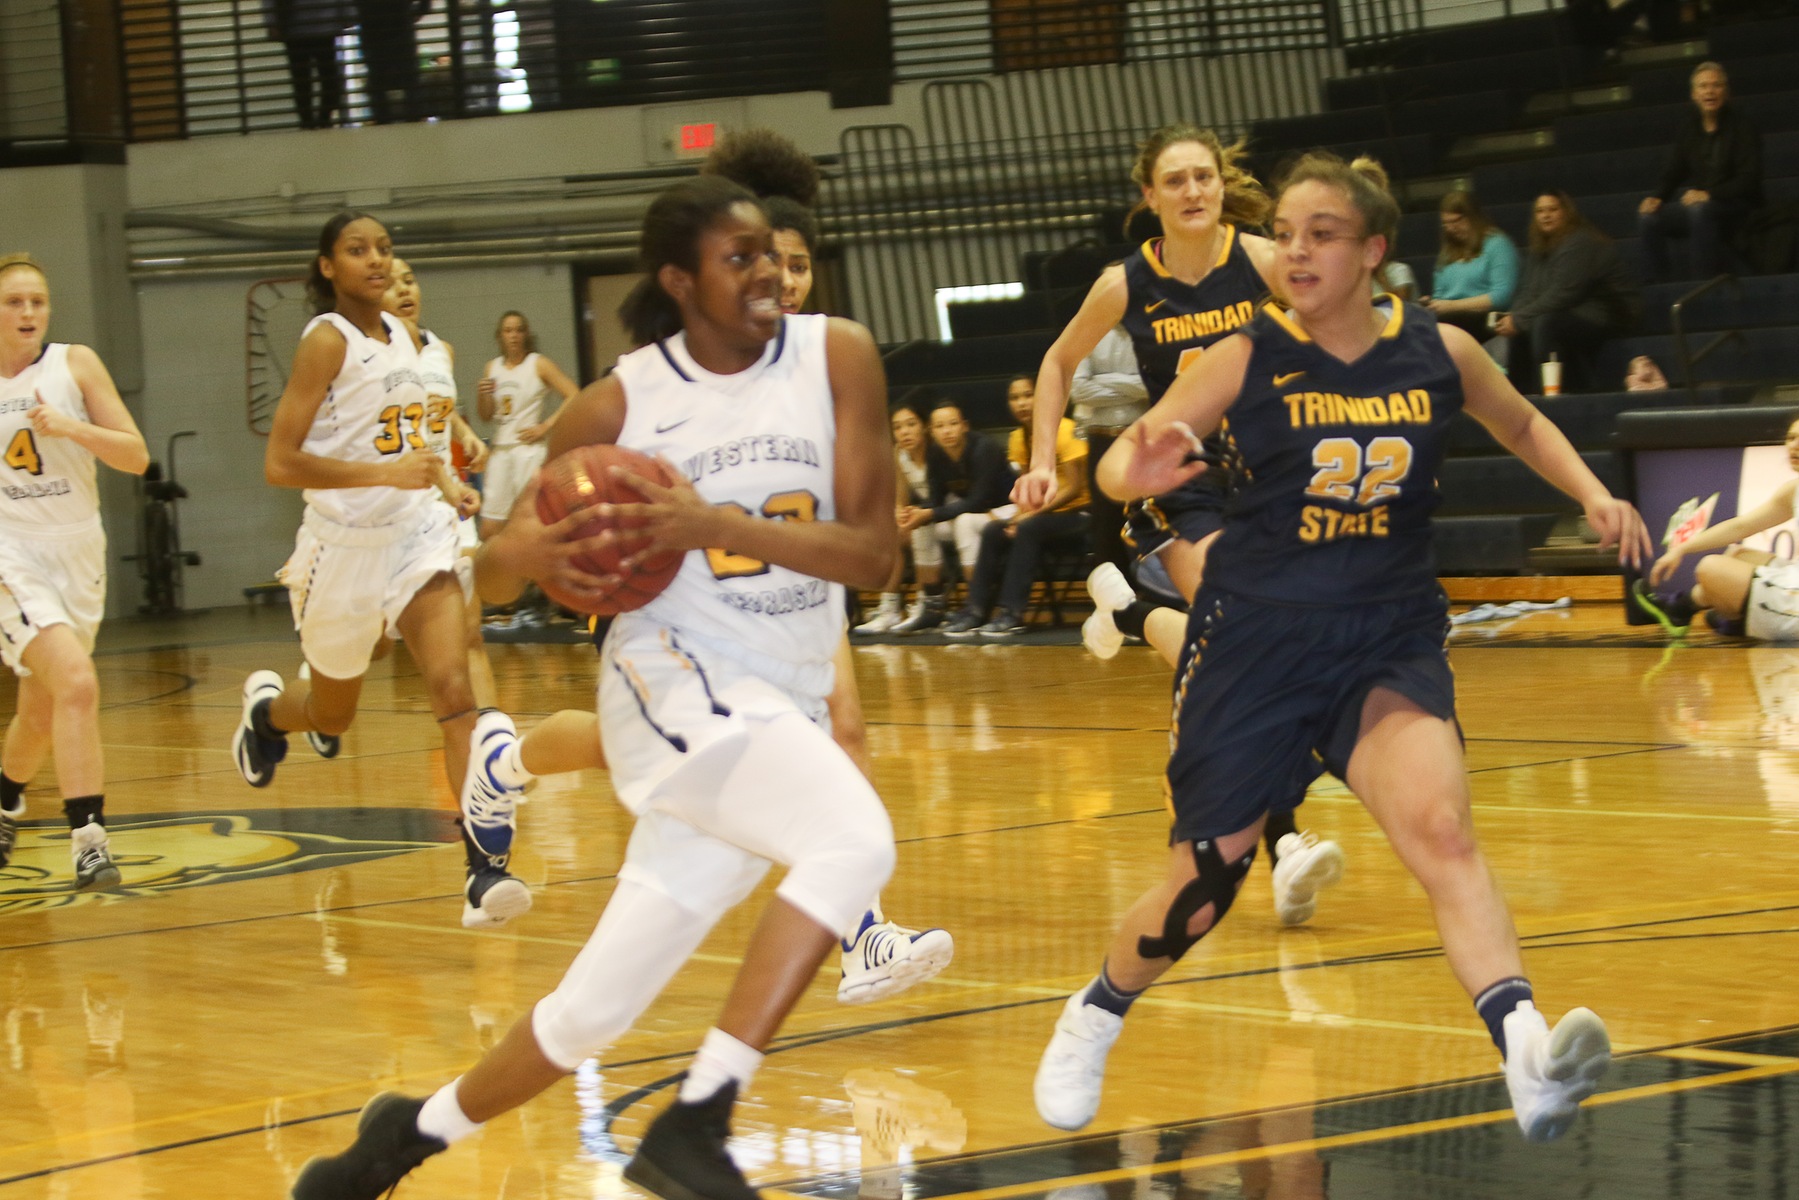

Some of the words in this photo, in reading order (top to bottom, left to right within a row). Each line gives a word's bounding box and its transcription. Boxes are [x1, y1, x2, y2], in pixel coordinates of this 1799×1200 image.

[1151, 300, 1253, 344] TRINIDAD
[374, 402, 425, 455] 33
[1283, 389, 1432, 428] TRINIDAD
[3, 427, 44, 477] 4
[682, 434, 820, 484] WESTERN
[1304, 436, 1413, 505] 22
